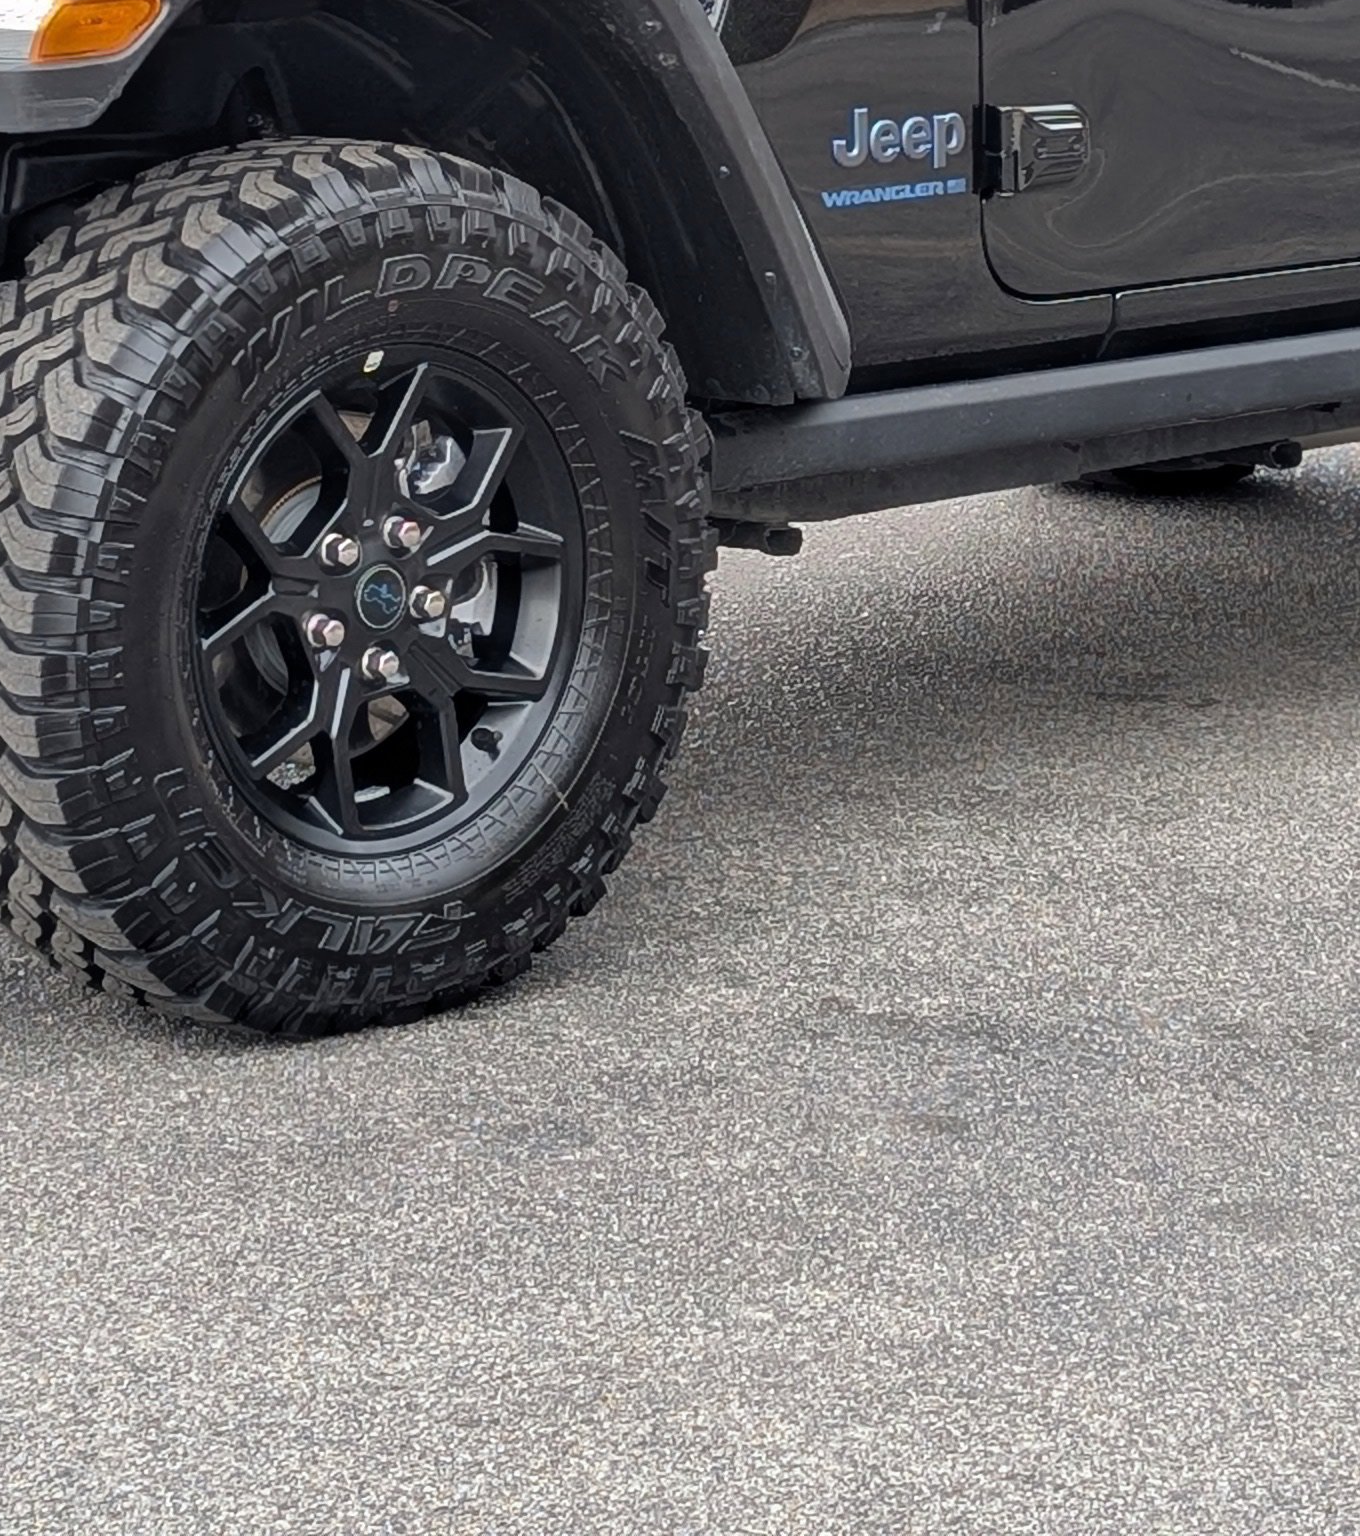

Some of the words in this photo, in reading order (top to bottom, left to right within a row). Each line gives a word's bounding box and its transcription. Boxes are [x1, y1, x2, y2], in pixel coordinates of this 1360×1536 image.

[832, 107, 966, 168] Jeep
[821, 180, 944, 208] WRANGLER
[232, 253, 626, 402] WILDPEAK
